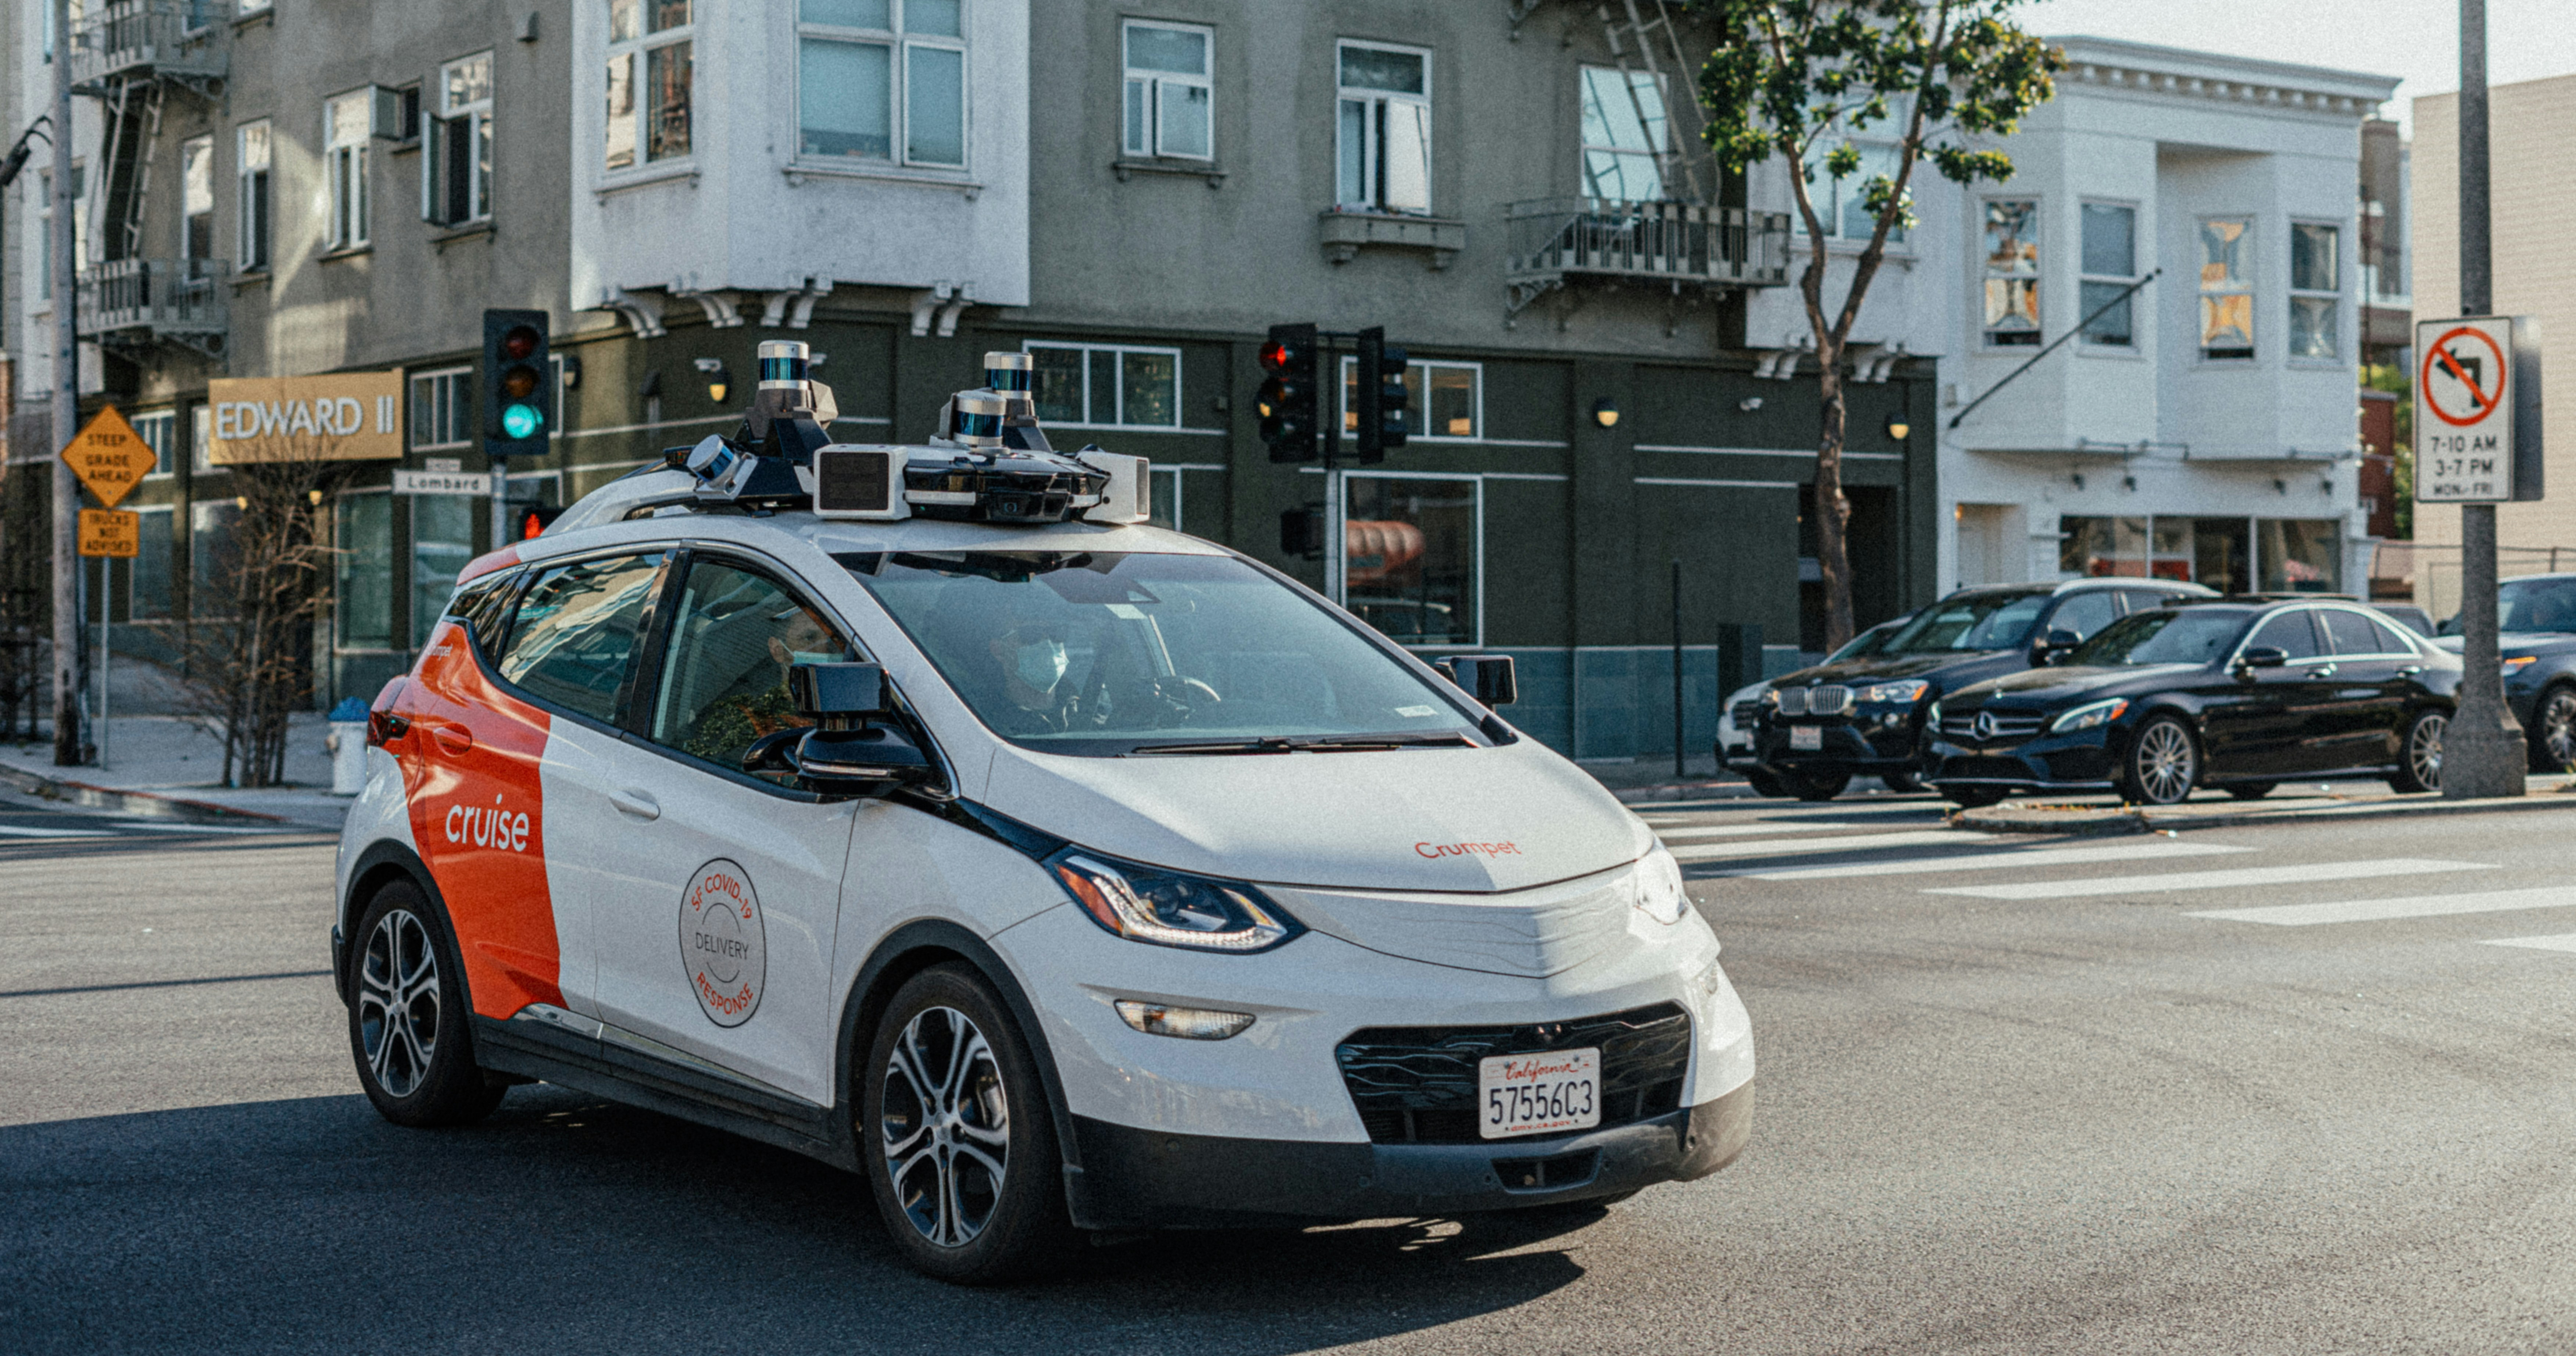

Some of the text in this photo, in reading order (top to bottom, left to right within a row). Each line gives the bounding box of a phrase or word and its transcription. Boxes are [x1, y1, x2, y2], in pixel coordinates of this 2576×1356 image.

[217, 397, 362, 440] EDWARD
[87, 434, 127, 446] STEEP
[2431, 435, 2497, 453] 7-10 AM
[86, 454, 129, 467] GRADE
[2436, 459, 2493, 476] 3-7 PM
[89, 470, 131, 483] AHEAD
[408, 476, 479, 489] Lombard
[89, 514, 129, 526] TRUCKS
[99, 527, 119, 538] NOT
[85, 540, 132, 552] ADVISED
[446, 793, 529, 852] cruise
[1414, 841, 1521, 859] Crumpet
[691, 874, 752, 919] SF COVID-19
[695, 932, 749, 960] DELIVERY
[697, 972, 753, 1015] RESPONSE
[1506, 1060, 1578, 1082] California
[1490, 1080, 1592, 1124] 57556C3
[1511, 1119, 1571, 1132] dmv.ca.gov
